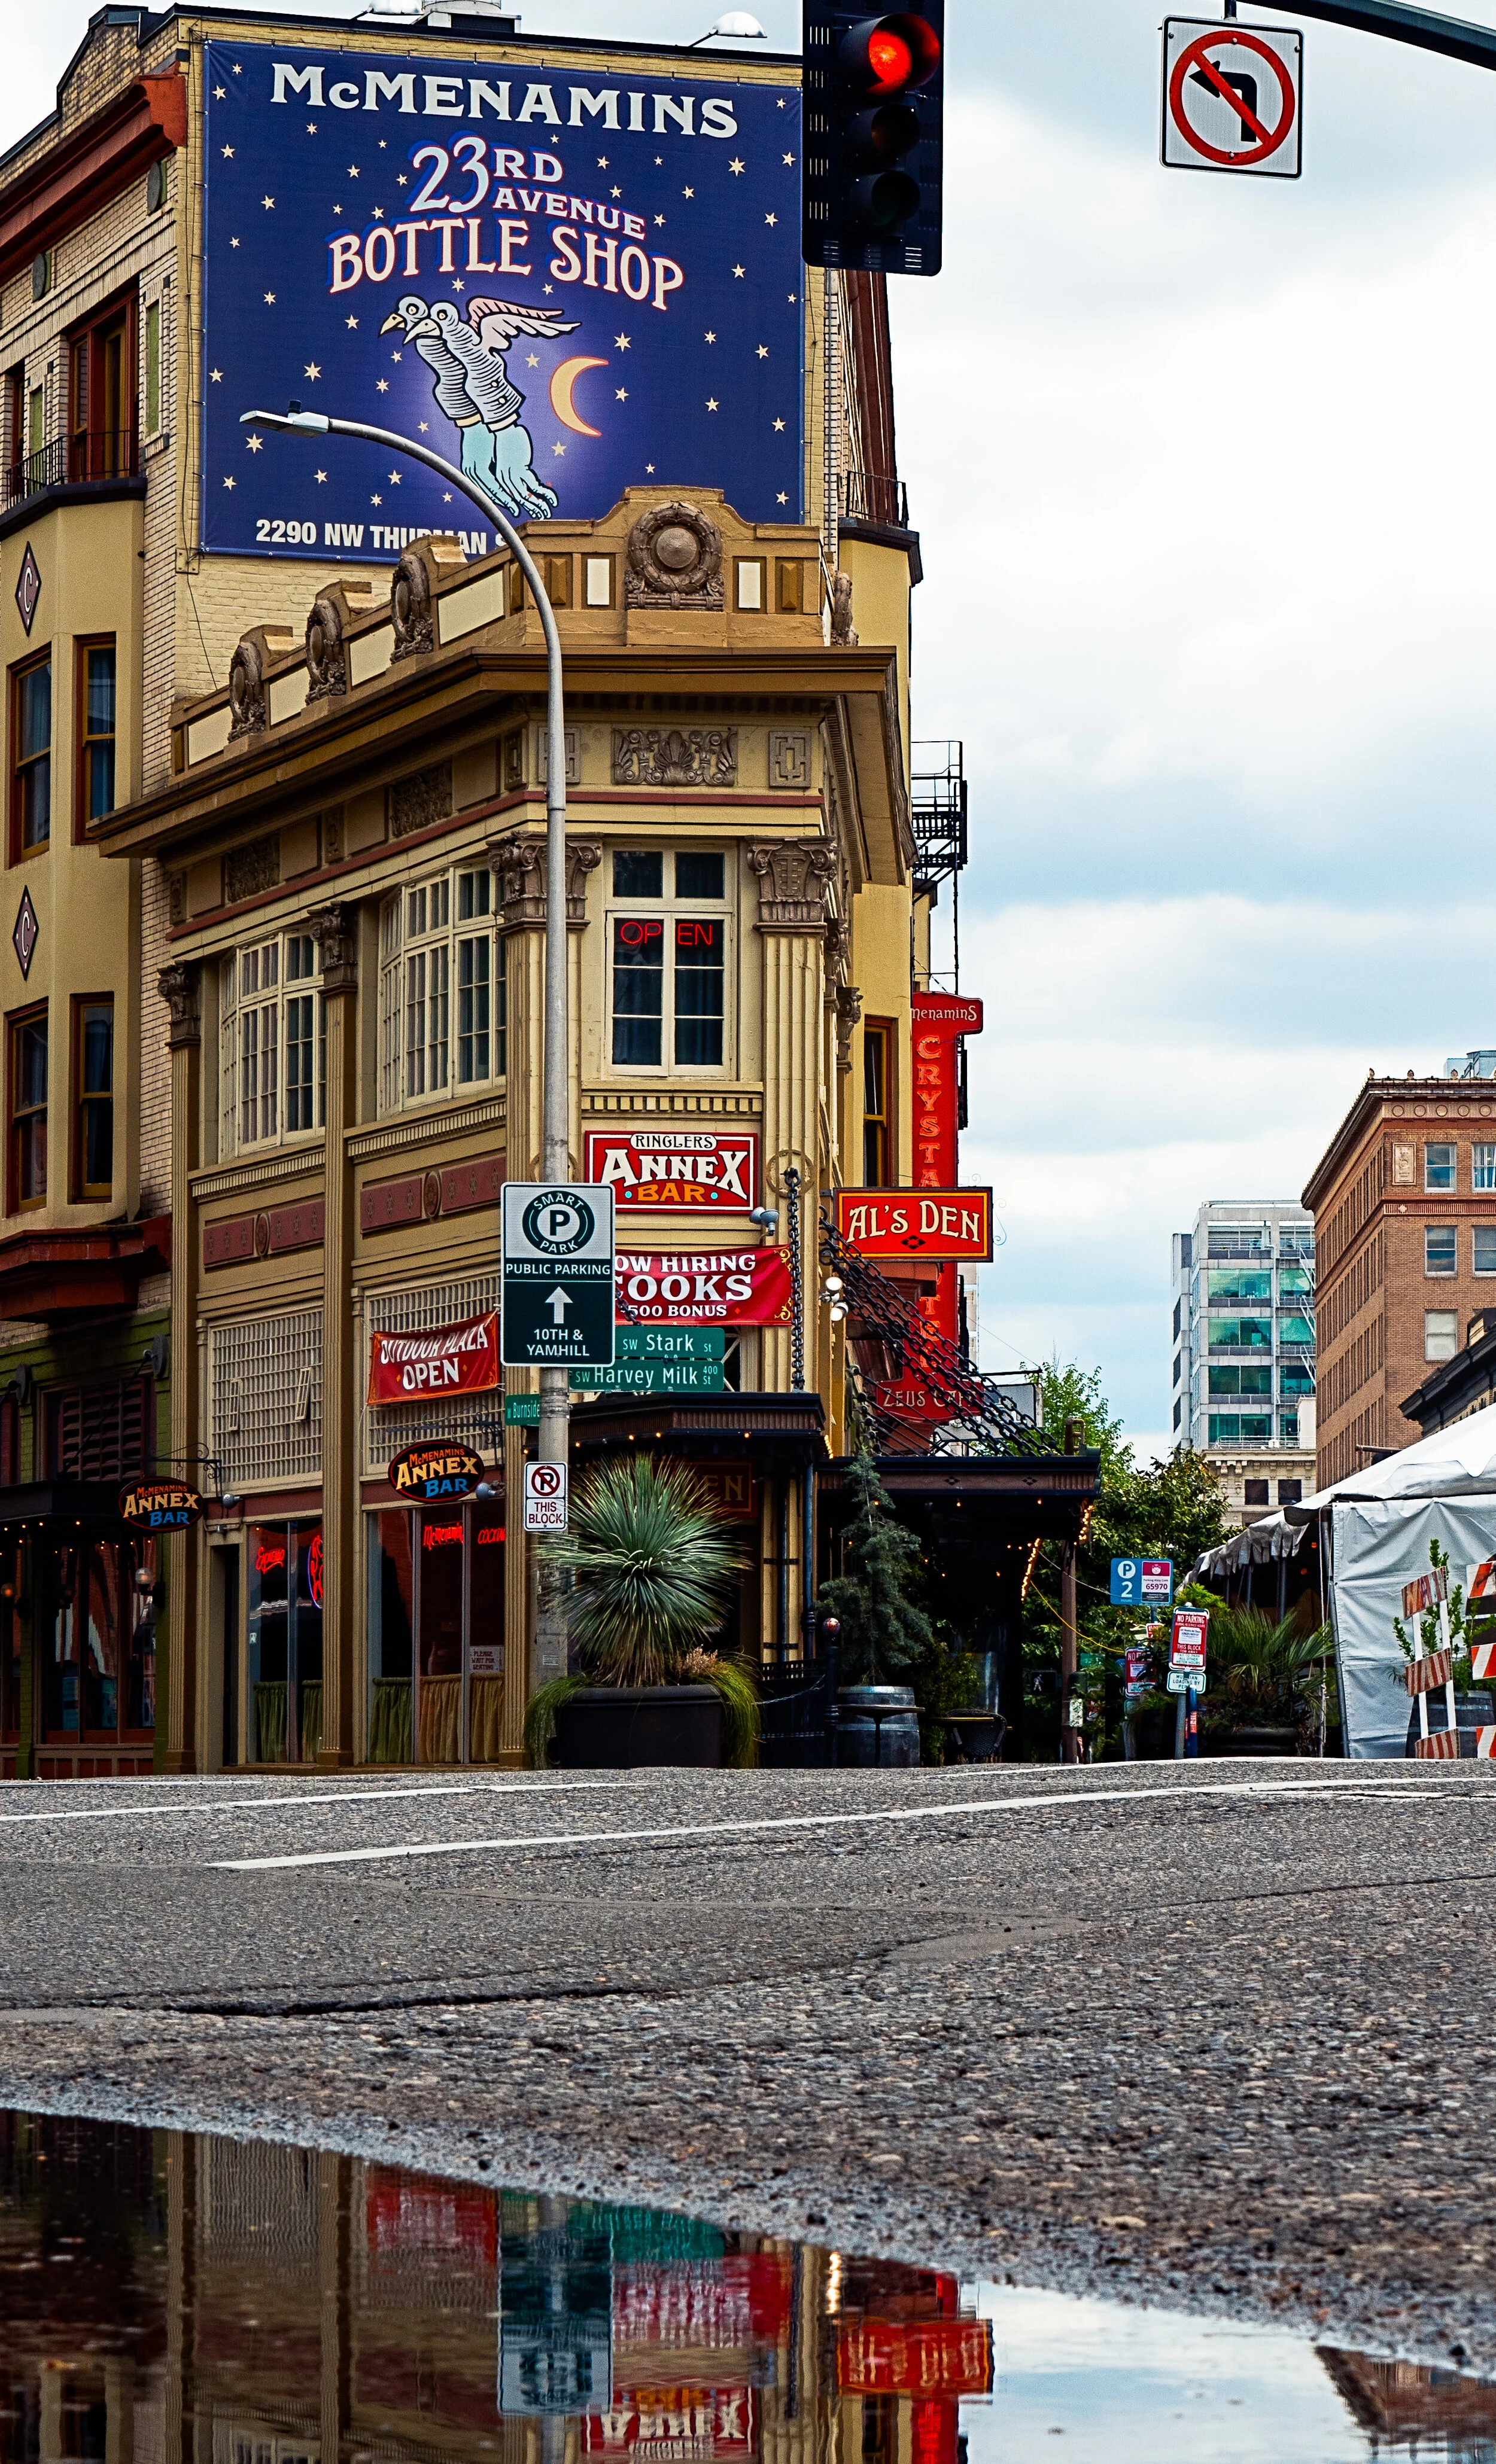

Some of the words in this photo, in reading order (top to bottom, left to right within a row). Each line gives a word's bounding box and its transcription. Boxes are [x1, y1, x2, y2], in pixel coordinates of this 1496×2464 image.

[270, 63, 738, 139] McMENAMINS
[409, 136, 564, 214] 23RD
[494, 187, 647, 240] AVENUE
[329, 217, 532, 294] BOTTLE
[549, 224, 685, 312] SHOP
[256, 519, 317, 545] 2290
[325, 523, 364, 547] NW
[370, 525, 486, 555] THUAN
[621, 921, 713, 946] OPEN
[636, 1135, 713, 1149] RINGLERS
[600, 1149, 748, 1201] ANNEX
[637, 1182, 706, 1202] BAR
[533, 1193, 584, 1210] SMART
[549, 1210, 571, 1236] P
[919, 1199, 981, 1243] DEN
[540, 1239, 579, 1254] PARK
[506, 1263, 551, 1275] PUBLIC
[555, 1264, 611, 1275] PARKING
[661, 1254, 756, 1272] HIRING
[620, 1304, 663, 1317] 500
[667, 1304, 727, 1317] BONUS
[534, 1328, 568, 1341] 10TH
[572, 1329, 583, 1341] &
[623, 1338, 638, 1351] SW
[646, 1333, 694, 1352] Stark
[704, 1343, 712, 1353] St
[381, 1334, 443, 1365] OUTDOOR
[441, 1323, 488, 1356] PLAZA
[527, 1344, 590, 1357] YAMHILL
[402, 1357, 460, 1391] OPEN
[575, 1370, 590, 1382] SW
[594, 1366, 654, 1388] Harvey
[662, 1367, 698, 1385] Milk
[703, 1365, 718, 1375] 400
[703, 1375, 711, 1385] St
[883, 1387, 926, 1407] ZEUS
[513, 1400, 540, 1418] Burnside
[409, 1448, 465, 1467] McMENAMINS
[395, 1457, 479, 1490] ANNEX
[136, 1485, 187, 1498] McMENAMINS
[424, 1478, 470, 1498] BAR
[123, 1493, 199, 1518] ANNEX
[534, 1501, 557, 1512] THIS
[149, 1511, 190, 1527] BAR
[528, 1513, 563, 1524] BLOCK
[1123, 1563, 1133, 1576] P
[1121, 1581, 1133, 1598] 2
[1185, 1615, 1205, 1624] PARKING
[1127, 1652, 1136, 1661] NO
